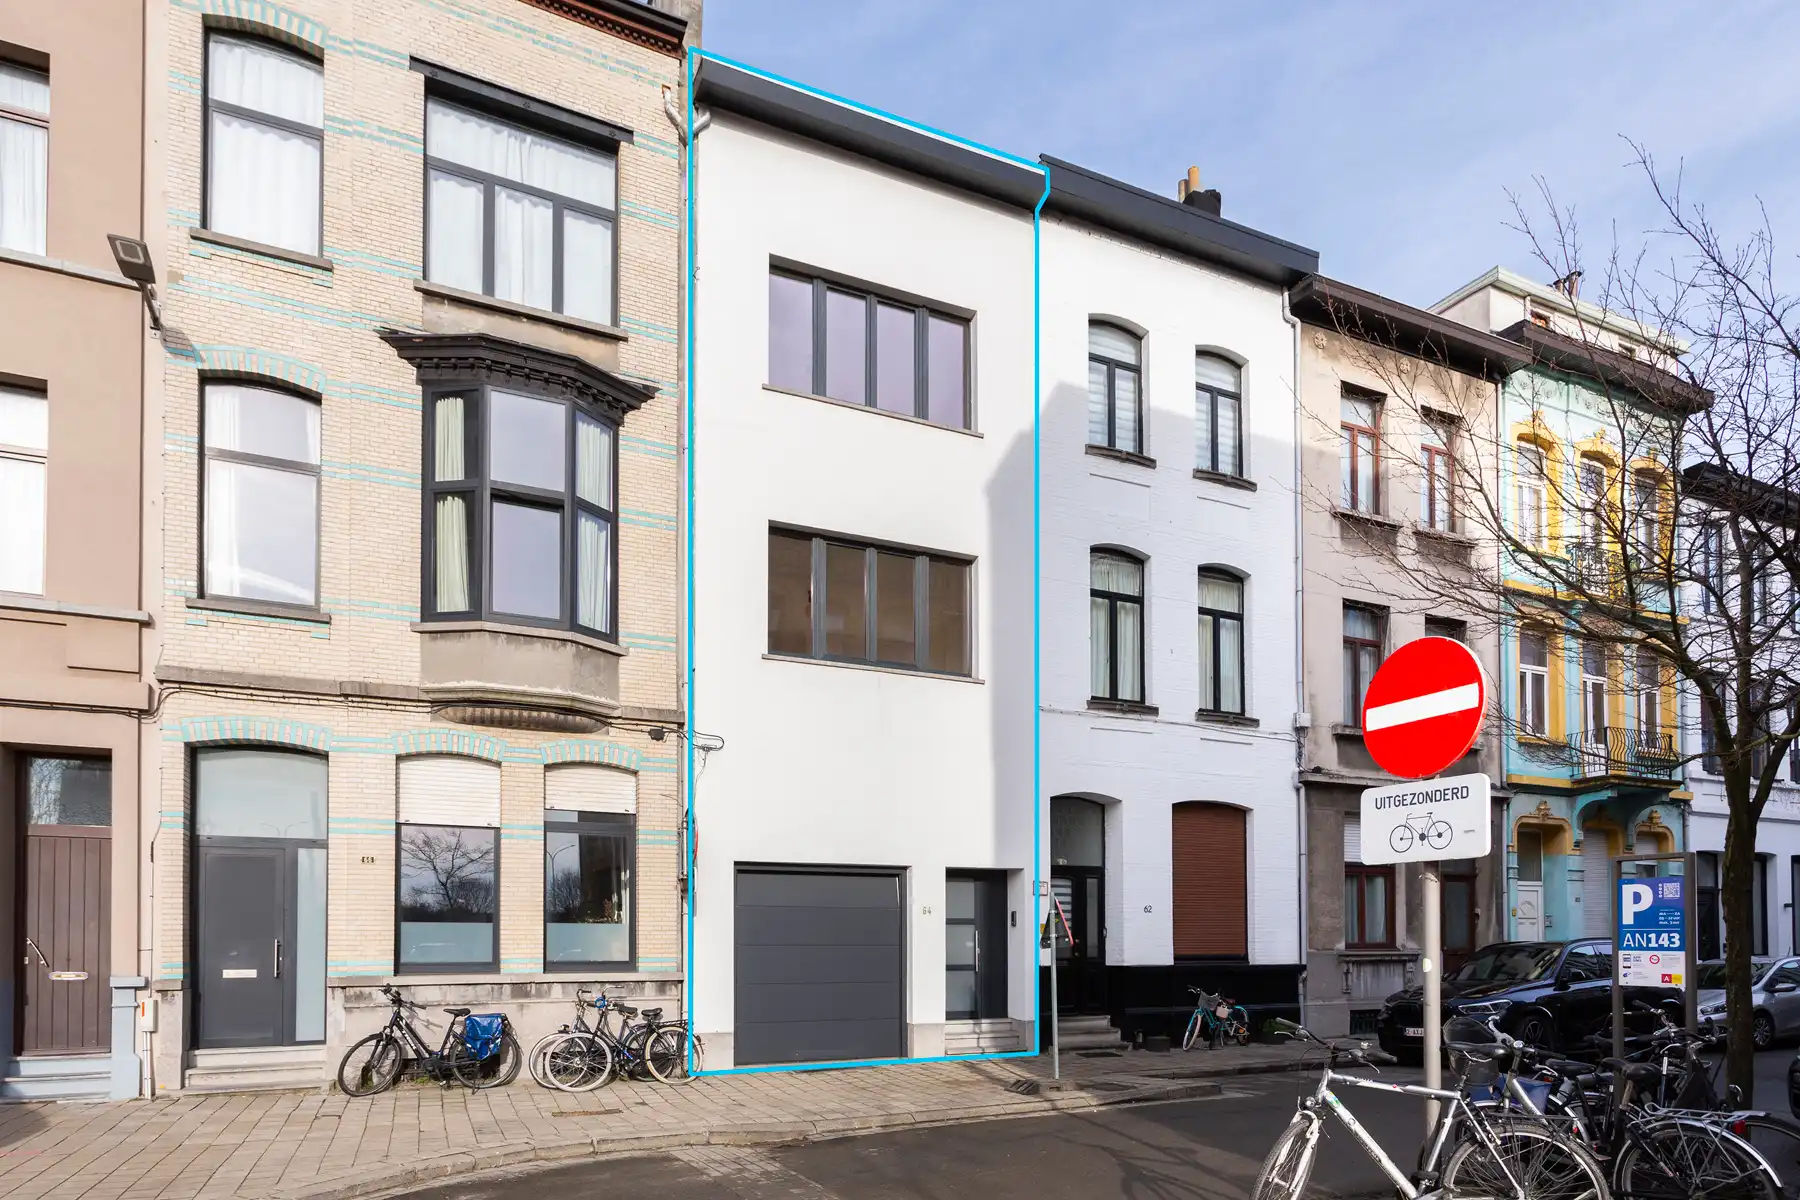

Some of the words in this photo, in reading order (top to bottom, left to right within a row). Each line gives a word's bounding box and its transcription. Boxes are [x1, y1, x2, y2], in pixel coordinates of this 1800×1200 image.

[1375, 785, 1470, 810] UITGEZONDERD
[922, 906, 932, 915] 64
[1143, 905, 1153, 914] 62
[1622, 884, 1653, 925] P
[1623, 933, 1680, 948] AN143
